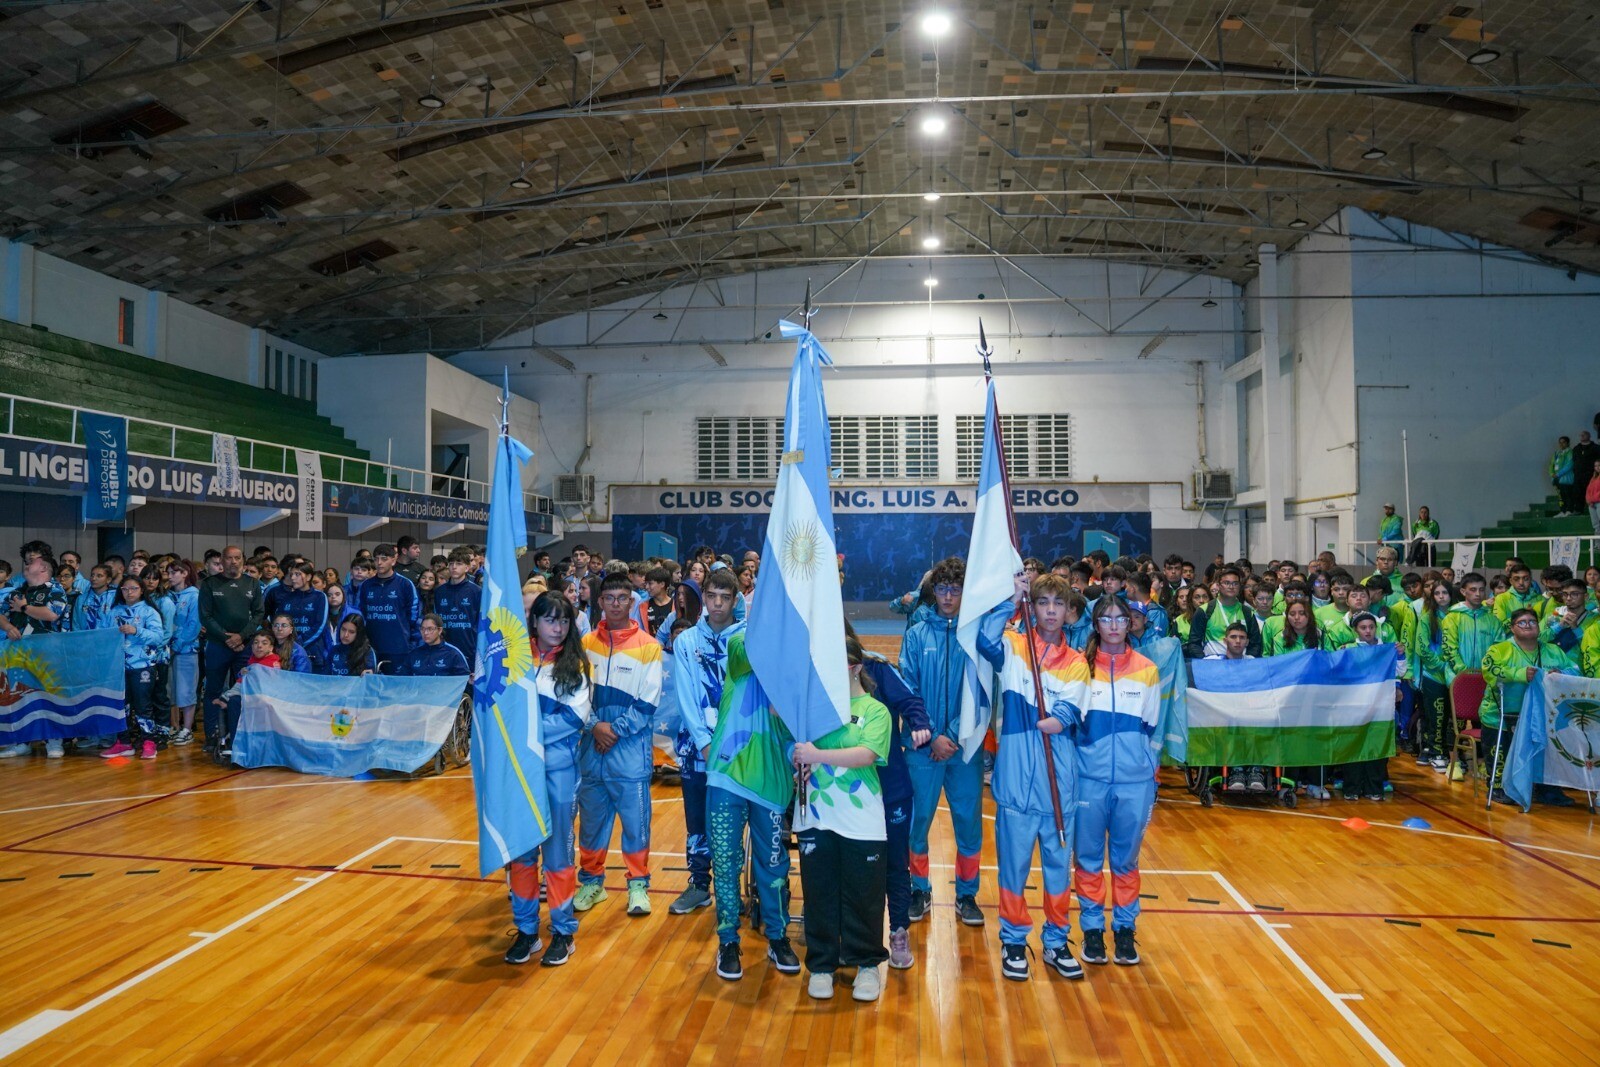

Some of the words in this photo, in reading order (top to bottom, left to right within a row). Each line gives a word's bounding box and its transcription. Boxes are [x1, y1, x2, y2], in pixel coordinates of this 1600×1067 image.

[20, 451, 154, 489] INGERO
[160, 469, 203, 495] LUIS
[100, 449, 110, 509] DEPORTES
[109, 450, 119, 508] CHUBUT
[388, 497, 446, 518] Municipalidad
[447, 505, 457, 517] de
[458, 506, 489, 522] Comodor
[659, 490, 723, 508] CLUB
[729, 490, 776, 508] SOC
[882, 490, 936, 507] LUIS
[943, 490, 968, 507] A.
[976, 489, 1079, 507] ERGO
[373, 613, 396, 621] Pampa
[448, 621, 471, 629] Pampa
